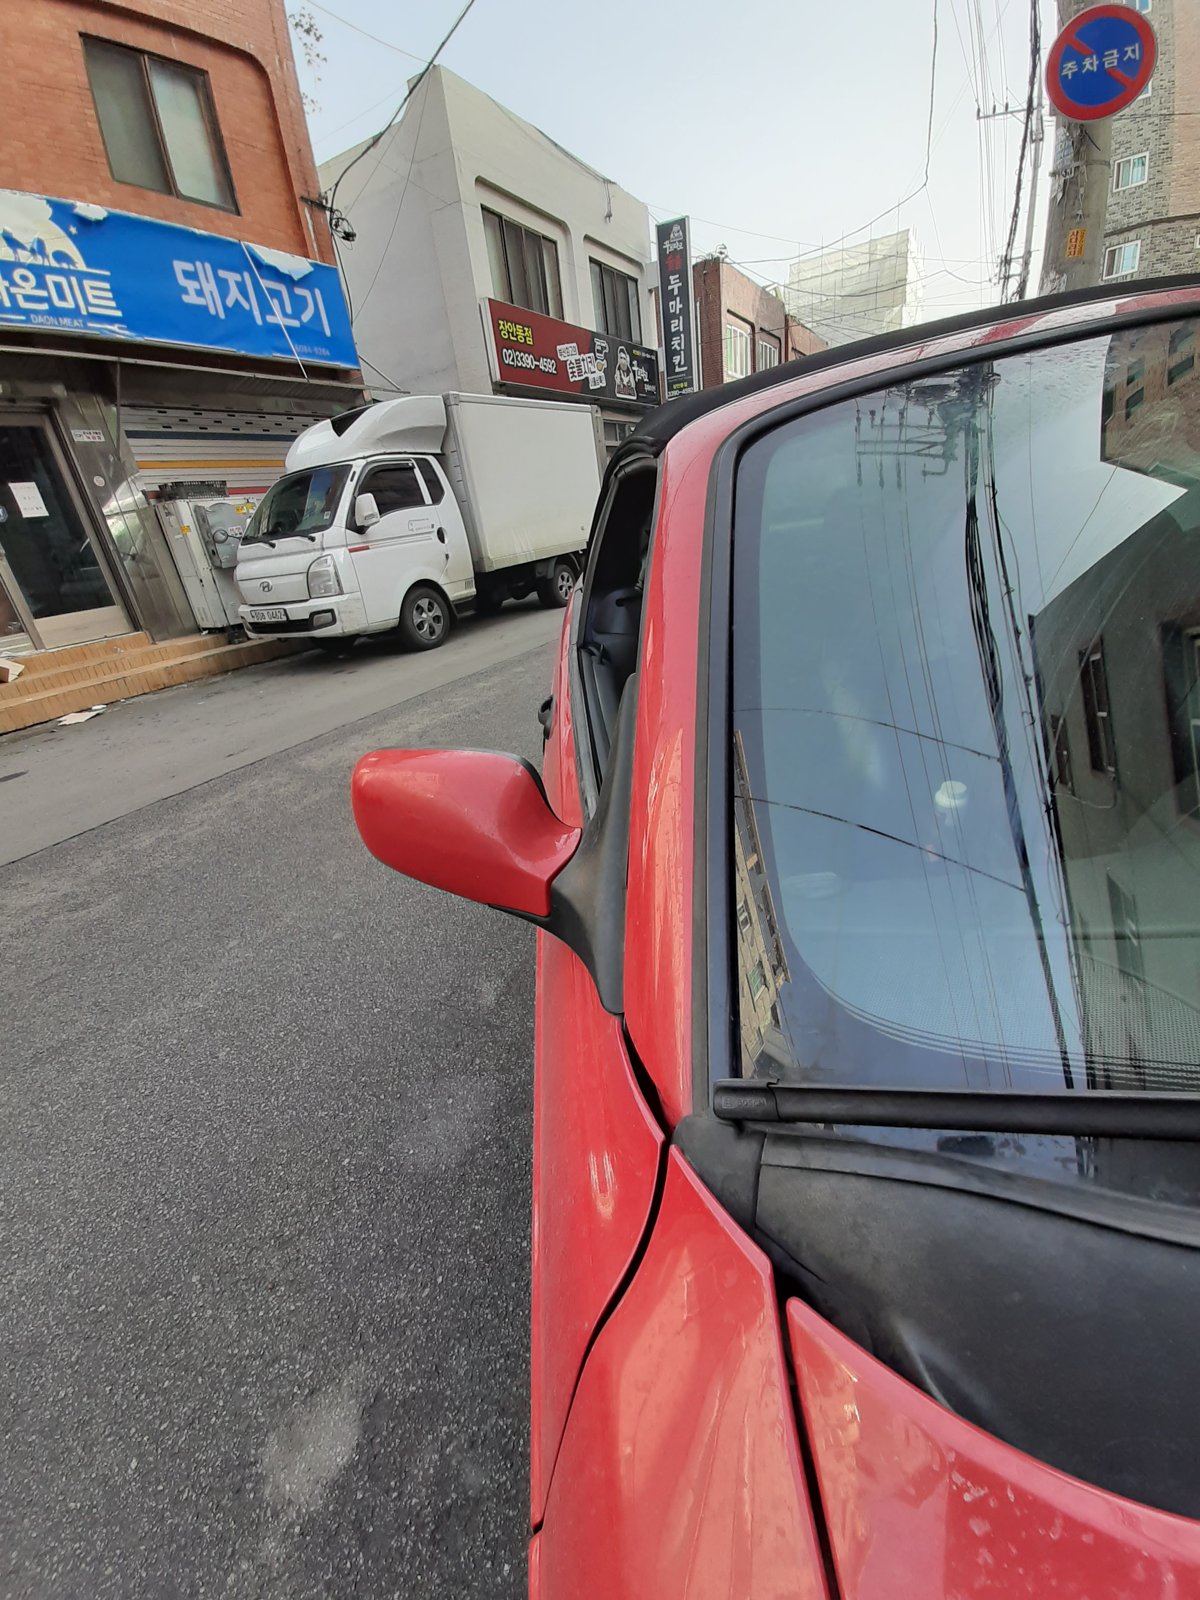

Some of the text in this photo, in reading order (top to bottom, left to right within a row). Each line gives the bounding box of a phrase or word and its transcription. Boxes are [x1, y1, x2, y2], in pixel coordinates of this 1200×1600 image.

[1061, 43, 1140, 80] 주차금지
[172, 259, 331, 338] 돼지고기
[59, 316, 84, 328] MEAT
[498, 319, 534, 346] 장안동점
[668, 275, 688, 372] 두마리치킨
[502, 347, 557, 374] 02)3390-4592
